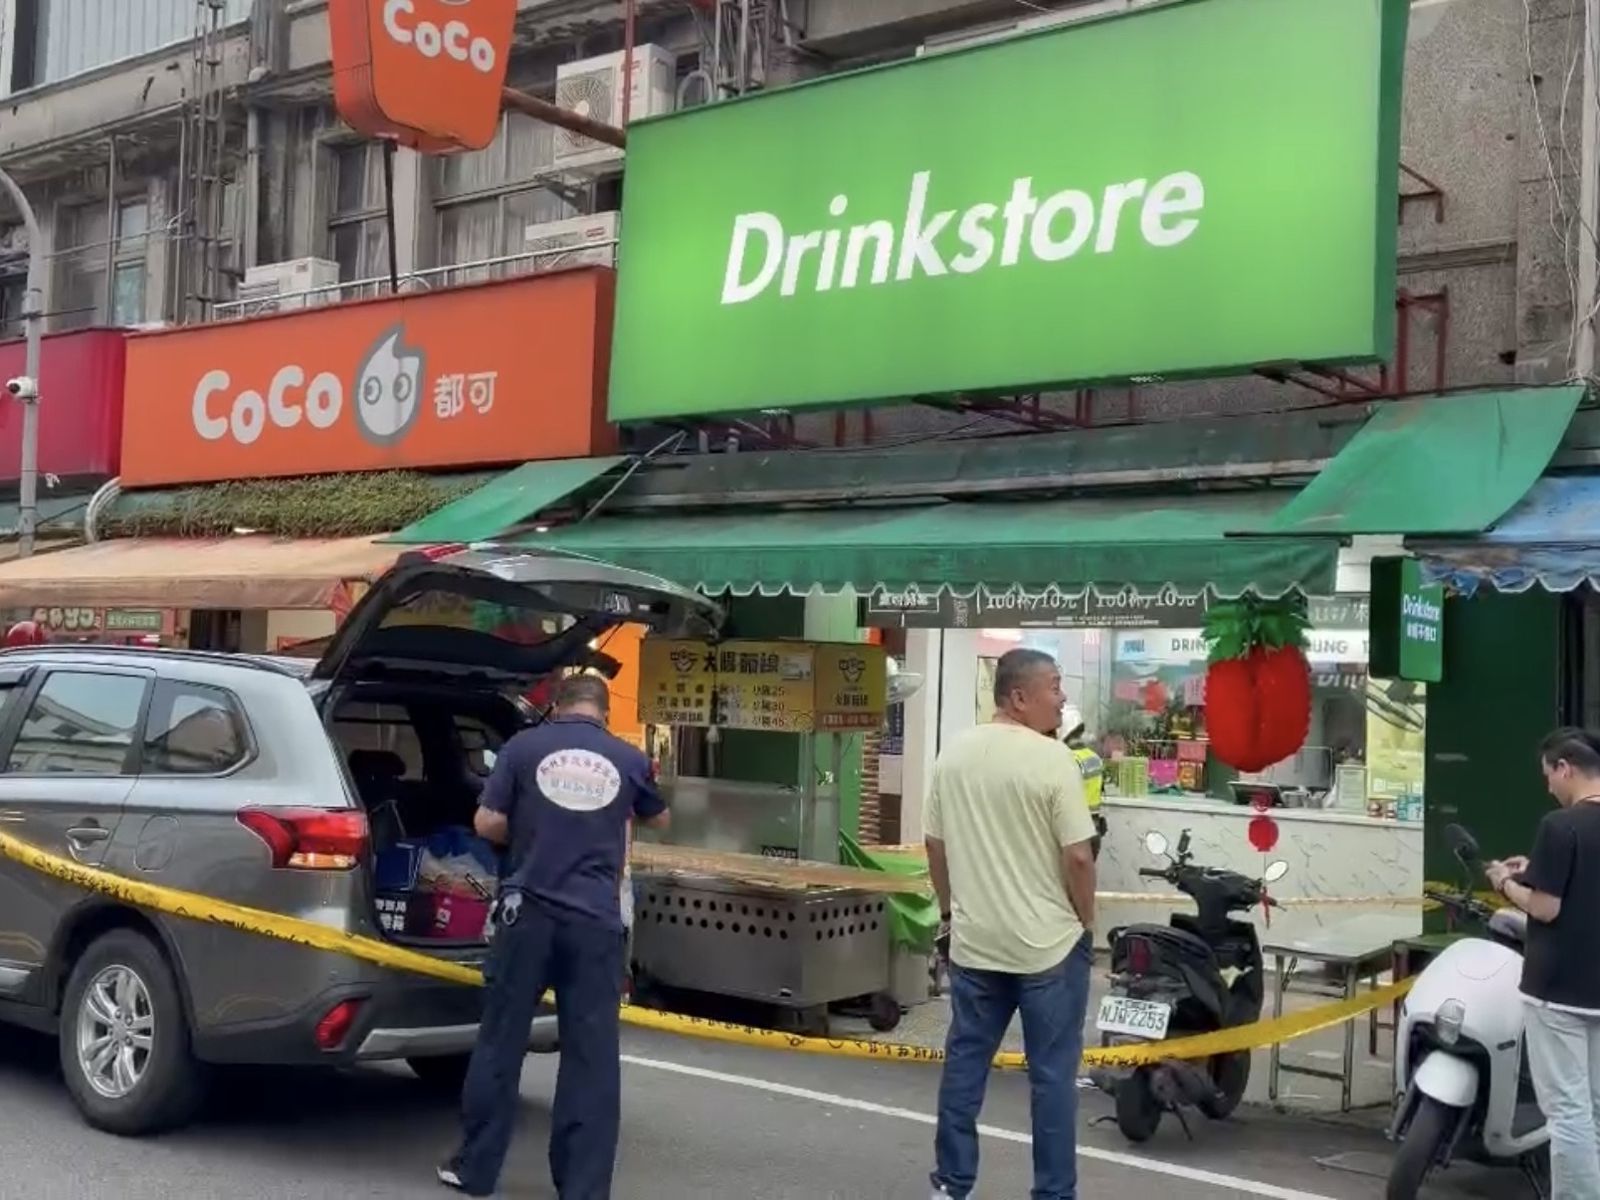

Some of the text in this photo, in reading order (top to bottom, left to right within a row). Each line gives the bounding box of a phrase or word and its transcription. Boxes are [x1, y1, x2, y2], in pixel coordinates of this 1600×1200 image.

[720, 170, 1206, 305] Drinkstore
[192, 365, 497, 444] CoCo 都可
